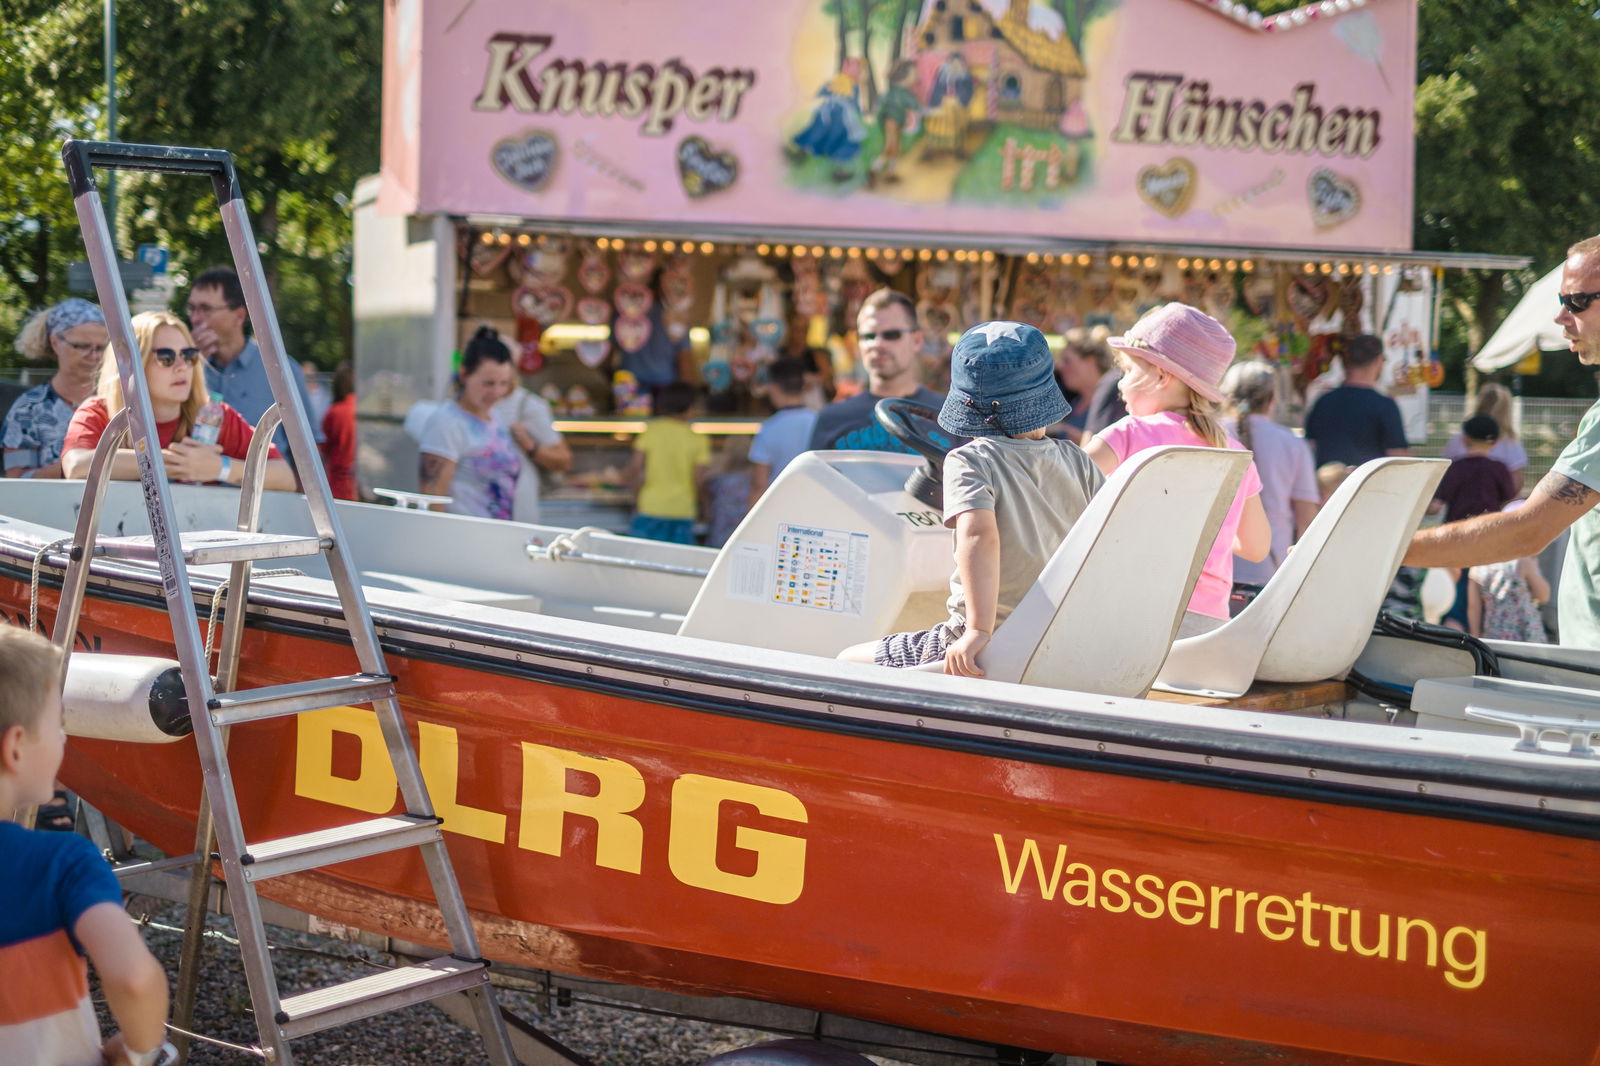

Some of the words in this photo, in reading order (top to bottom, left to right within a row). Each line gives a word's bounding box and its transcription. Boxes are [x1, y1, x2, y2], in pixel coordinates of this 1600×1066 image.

[472, 32, 755, 136] Knusper
[1112, 71, 1382, 159] Häuschen
[295, 706, 808, 905] DLRG
[993, 833, 1487, 989] Wasserrettung
